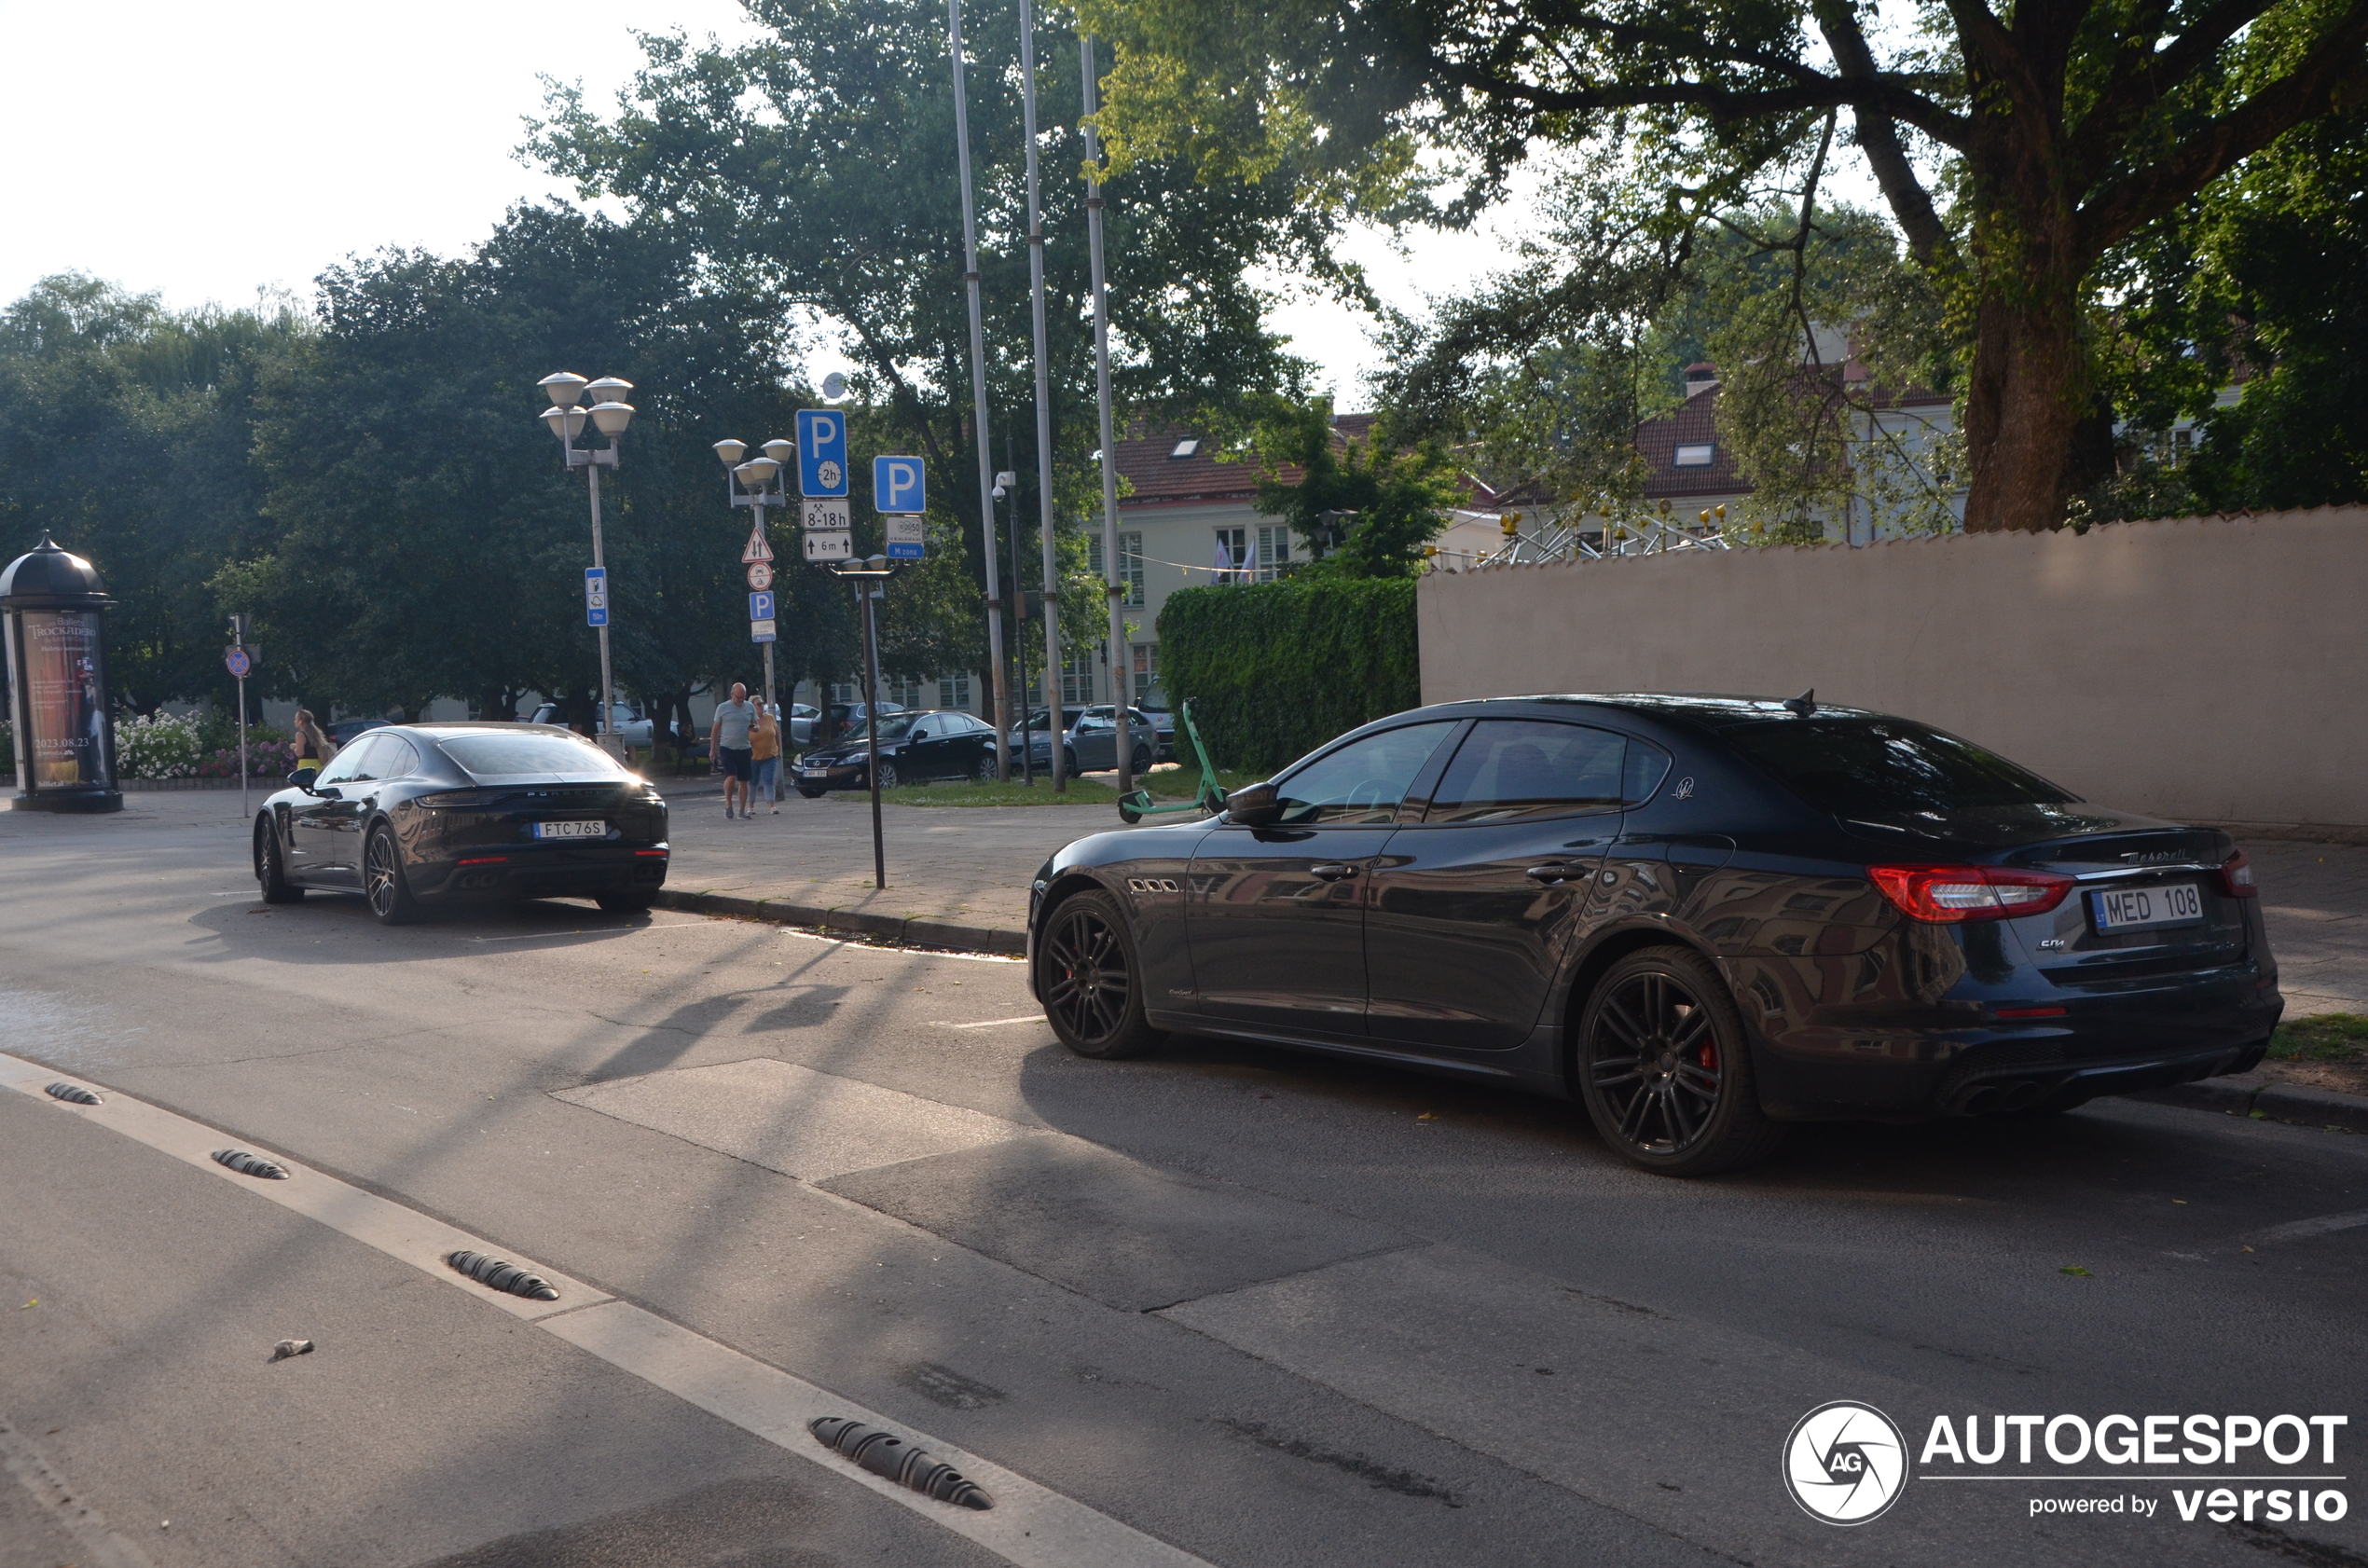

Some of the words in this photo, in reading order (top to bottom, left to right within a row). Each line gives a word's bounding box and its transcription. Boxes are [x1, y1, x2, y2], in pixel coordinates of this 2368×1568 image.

[811, 417, 836, 459] P
[823, 469, 837, 481] 2h
[889, 463, 916, 505] P
[821, 542, 827, 551] 6
[756, 595, 769, 617] P
[57, 617, 85, 627] Ballets
[35, 738, 89, 749] 2023.08.23
[545, 823, 571, 836] FTC
[574, 822, 600, 834] 76S
[2121, 849, 2190, 866] Maserati
[2106, 892, 2152, 923] MED
[2165, 888, 2198, 916] 108
[2097, 914, 2105, 923] LT
